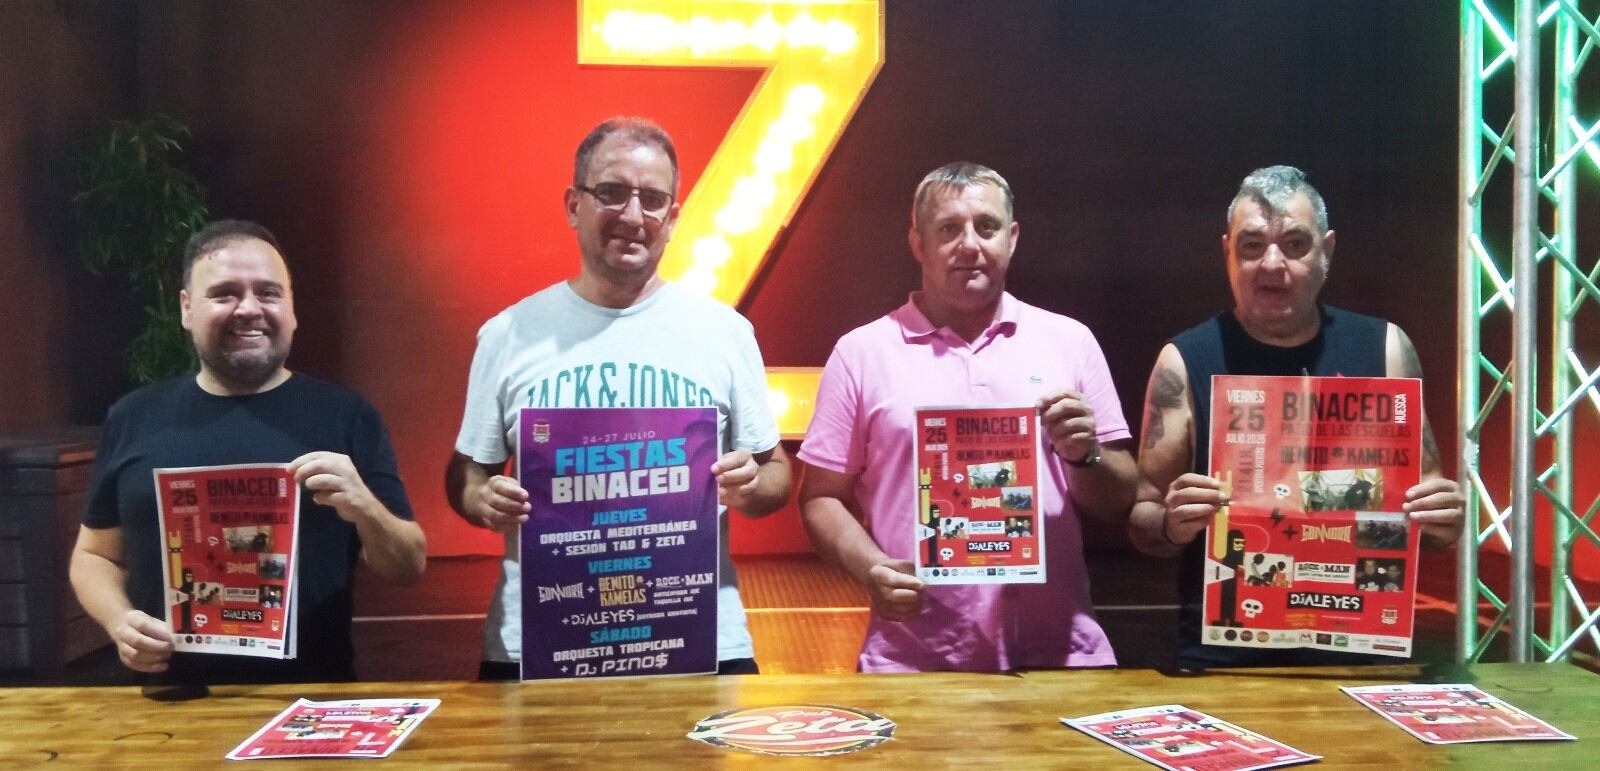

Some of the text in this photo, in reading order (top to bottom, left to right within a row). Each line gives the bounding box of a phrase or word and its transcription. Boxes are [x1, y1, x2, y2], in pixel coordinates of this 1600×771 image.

[1227, 389, 1265, 404] VIERNES
[1281, 392, 1392, 423] BINACED
[1395, 393, 1406, 424] HUESCA
[956, 416, 1019, 436] BINACED
[1228, 405, 1265, 431] 25
[583, 430, 656, 445] 24-27 JULIO
[926, 428, 947, 444] 25
[1316, 424, 1329, 437] DE
[1332, 424, 1352, 437] LAS
[555, 437, 687, 476] FIESTAS
[1347, 448, 1409, 466] KAMELAS
[552, 465, 690, 504] BINACED
[172, 489, 197, 506] 25
[592, 508, 648, 526] JUEVES
[540, 520, 697, 545] ORQUESTA MEDITERRÁNEA
[565, 541, 607, 556] SESIÓN
[656, 535, 686, 547] ZETA
[588, 556, 652, 574] VIERNES
[598, 575, 635, 592] BENITO
[600, 589, 647, 607] KAMELAS
[591, 625, 652, 643] SÁBADO
[554, 638, 684, 662] ORQUESTA TROPICANA
